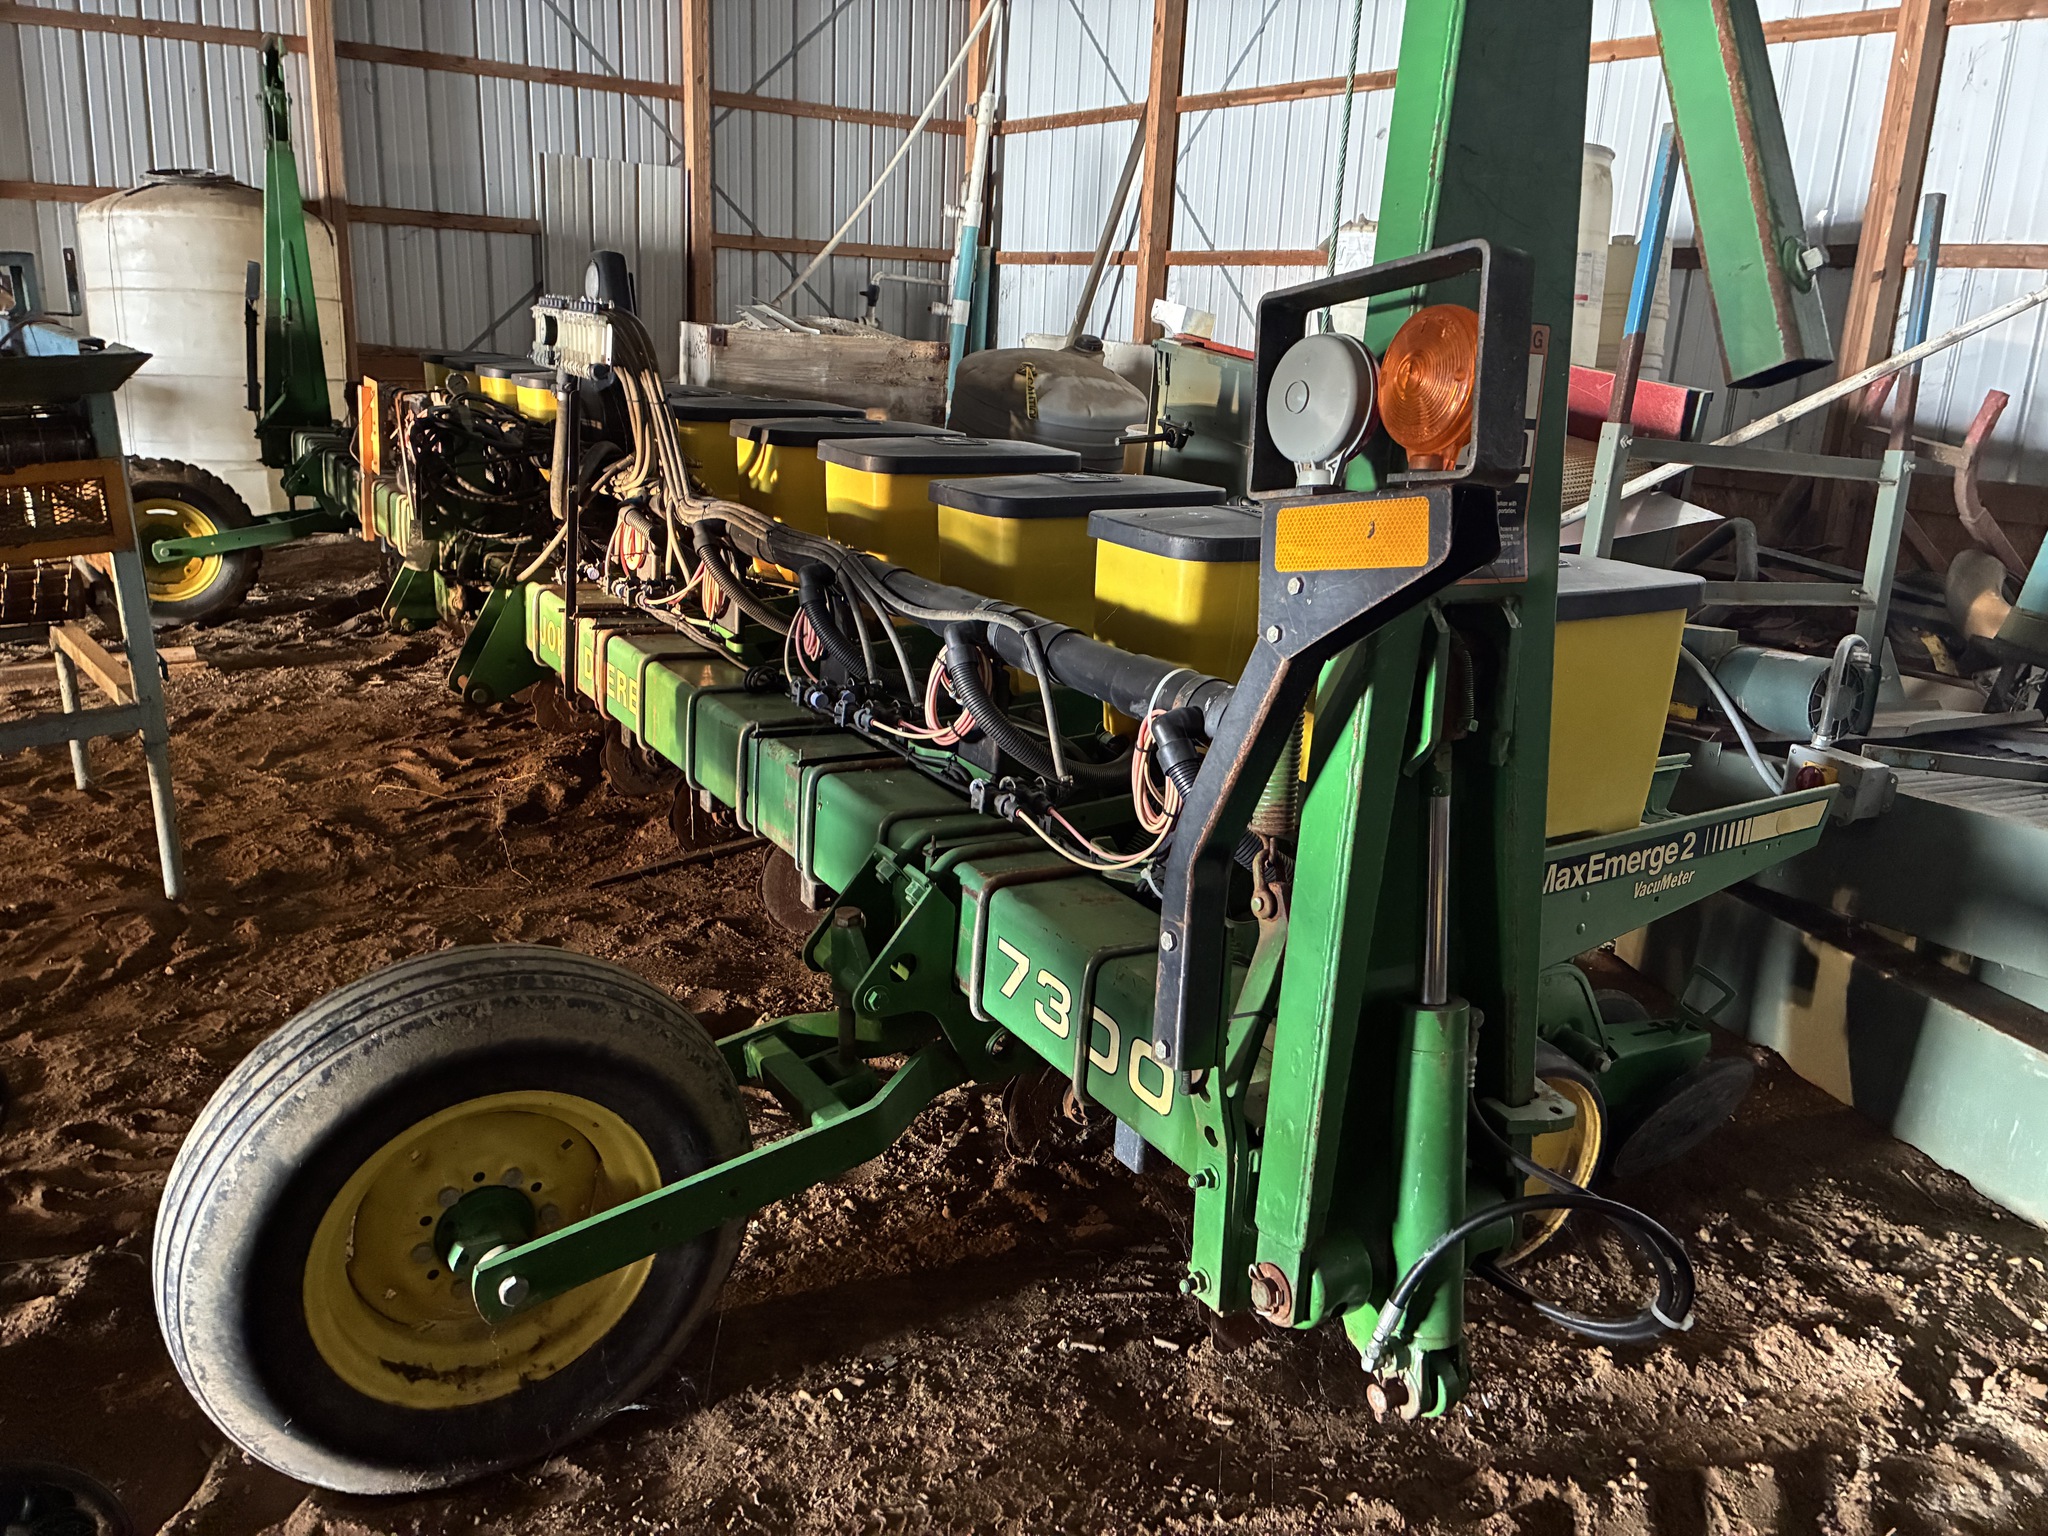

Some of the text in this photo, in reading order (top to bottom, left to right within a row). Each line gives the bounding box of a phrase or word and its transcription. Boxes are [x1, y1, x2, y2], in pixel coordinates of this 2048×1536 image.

[584, 644, 638, 717] DERE
[1680, 831, 1697, 861] 2
[1633, 869, 1696, 899] VacuMeter
[998, 936, 1175, 1117] 7300
